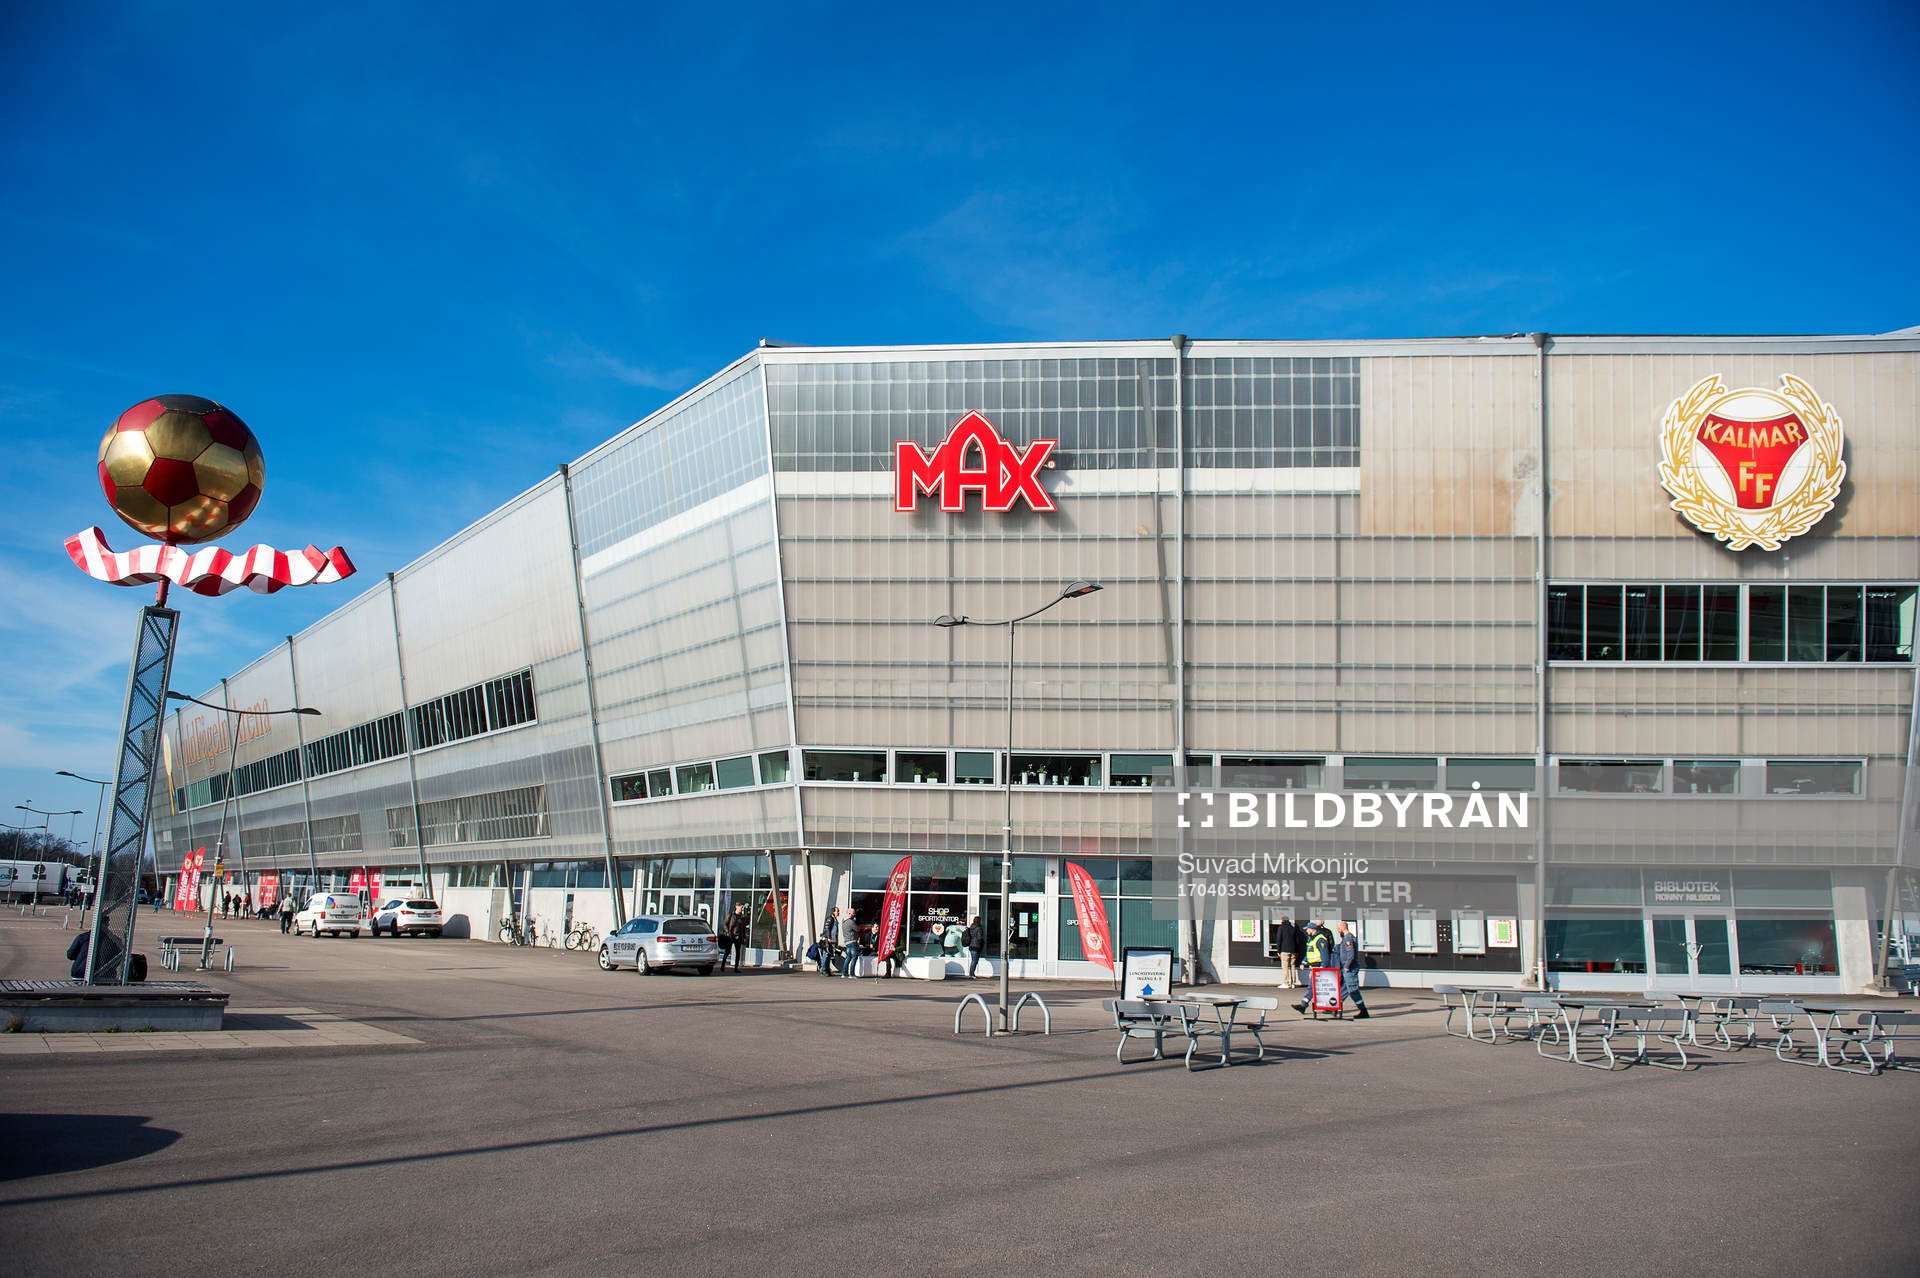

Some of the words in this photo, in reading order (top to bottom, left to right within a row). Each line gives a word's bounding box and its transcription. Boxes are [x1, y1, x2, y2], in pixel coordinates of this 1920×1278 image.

[1703, 420, 1803, 448] KALMAR
[894, 409, 1058, 512] MAX
[1739, 461, 1773, 503] FF
[1262, 879, 1412, 903] BILJETTER
[1654, 881, 1720, 892] BIBLIOTEK
[1655, 893, 1684, 901] RONNY
[1686, 893, 1720, 901] NILSSON
[928, 907, 949, 916] SHOP
